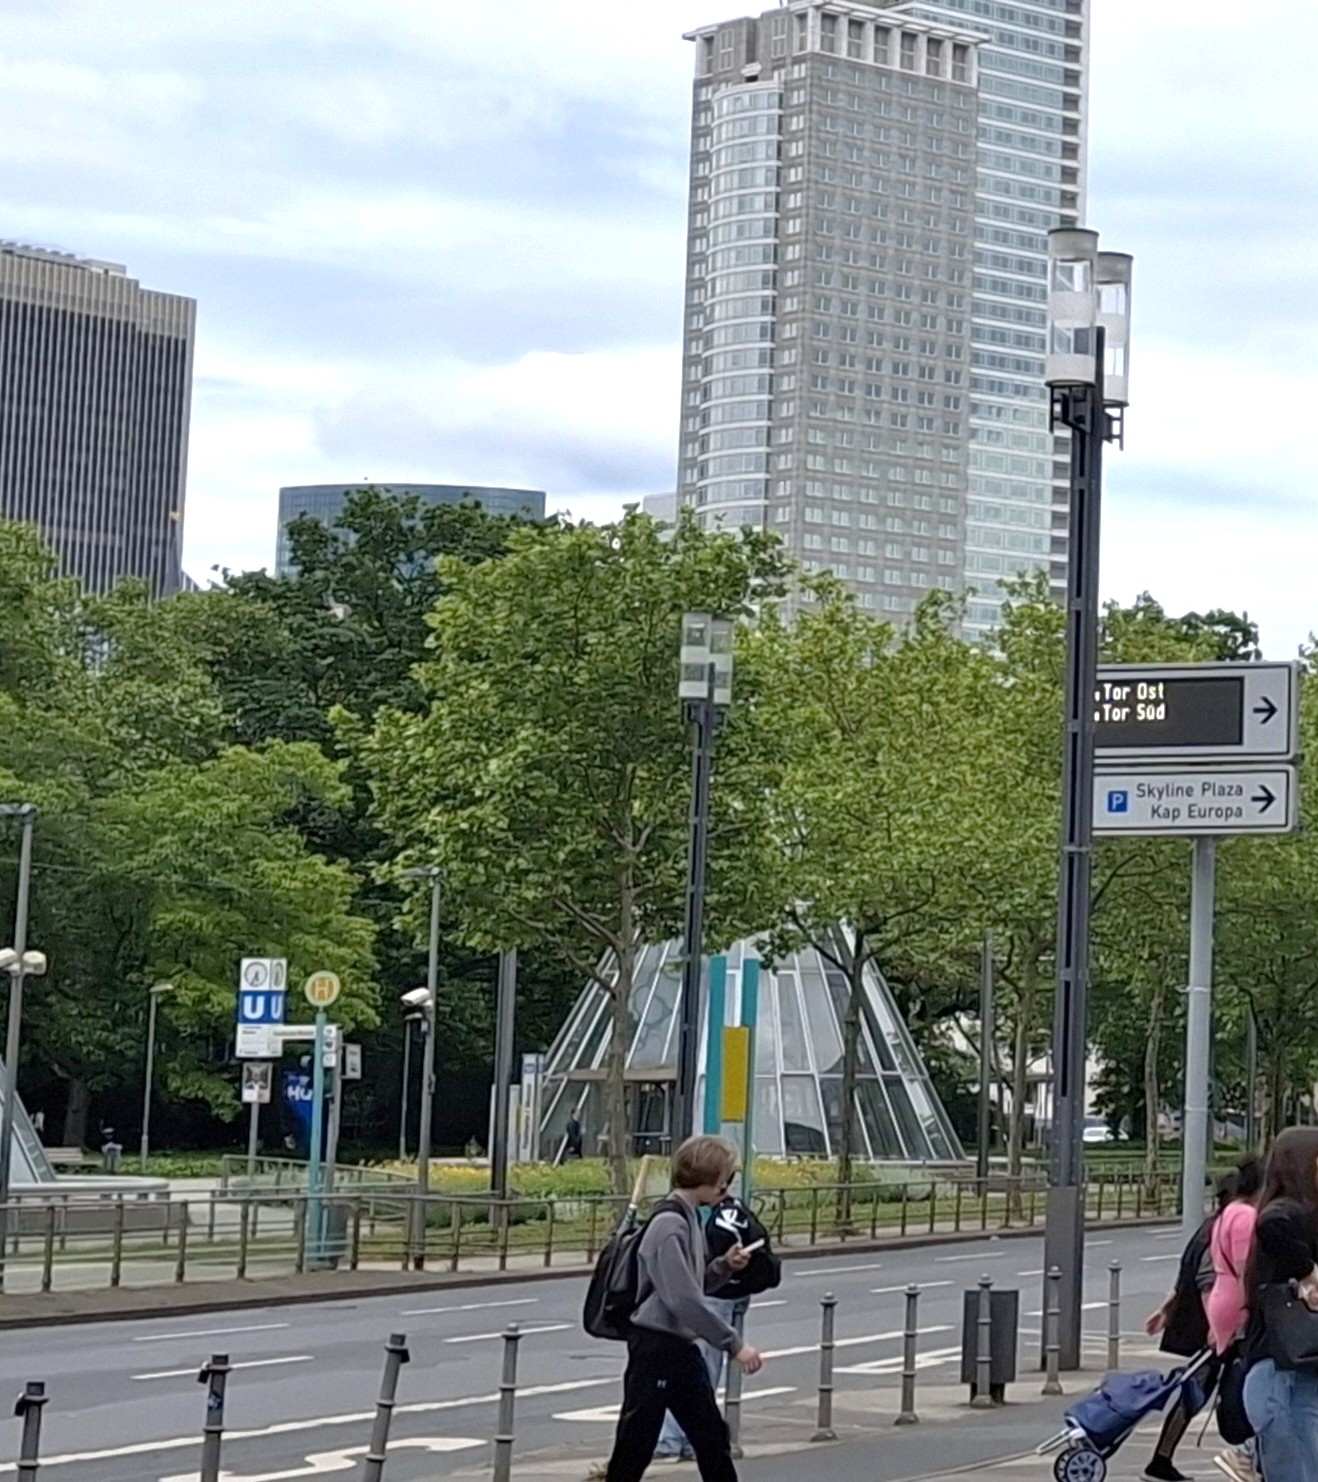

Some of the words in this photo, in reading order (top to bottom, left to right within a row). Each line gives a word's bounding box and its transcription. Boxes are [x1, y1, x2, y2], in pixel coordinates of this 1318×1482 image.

[1103, 683, 1131, 701] Tor
[1137, 682, 1165, 700] Ost
[1102, 703, 1131, 722] Tor
[1136, 703, 1166, 721] Süd
[1136, 782, 1194, 801] Skyline
[1201, 781, 1244, 798] Plaza
[1111, 794, 1124, 810] P
[1151, 805, 1181, 822] Kap
[1187, 804, 1243, 822] Europa
[315, 979, 329, 999] H
[243, 996, 264, 1019] U
[270, 996, 283, 1019] U
